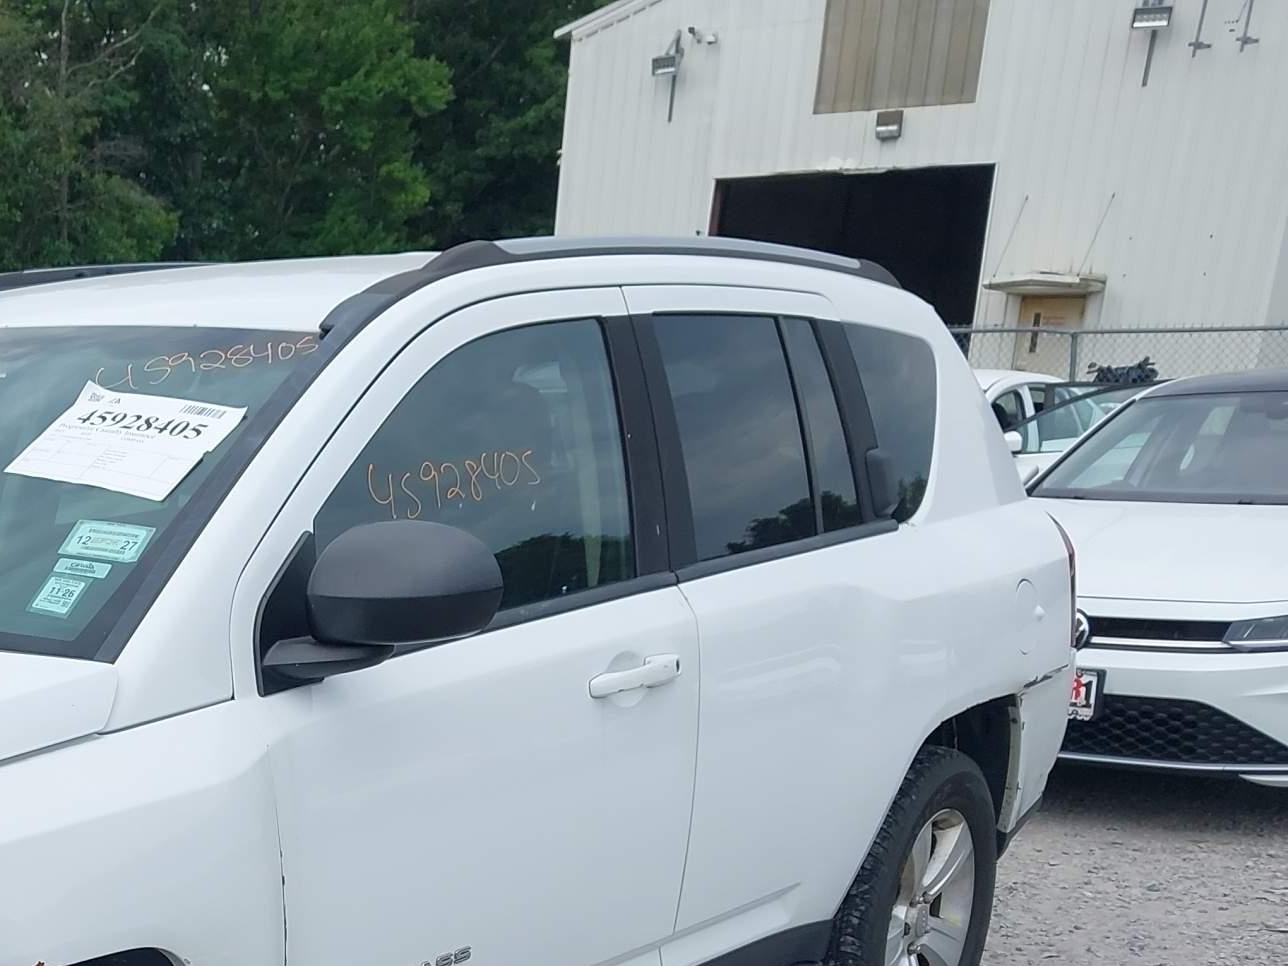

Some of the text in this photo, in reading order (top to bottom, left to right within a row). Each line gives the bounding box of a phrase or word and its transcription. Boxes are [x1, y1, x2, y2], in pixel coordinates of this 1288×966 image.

[76, 408, 209, 440] 45928405
[76, 535, 92, 546] 12
[119, 540, 139, 552] 27
